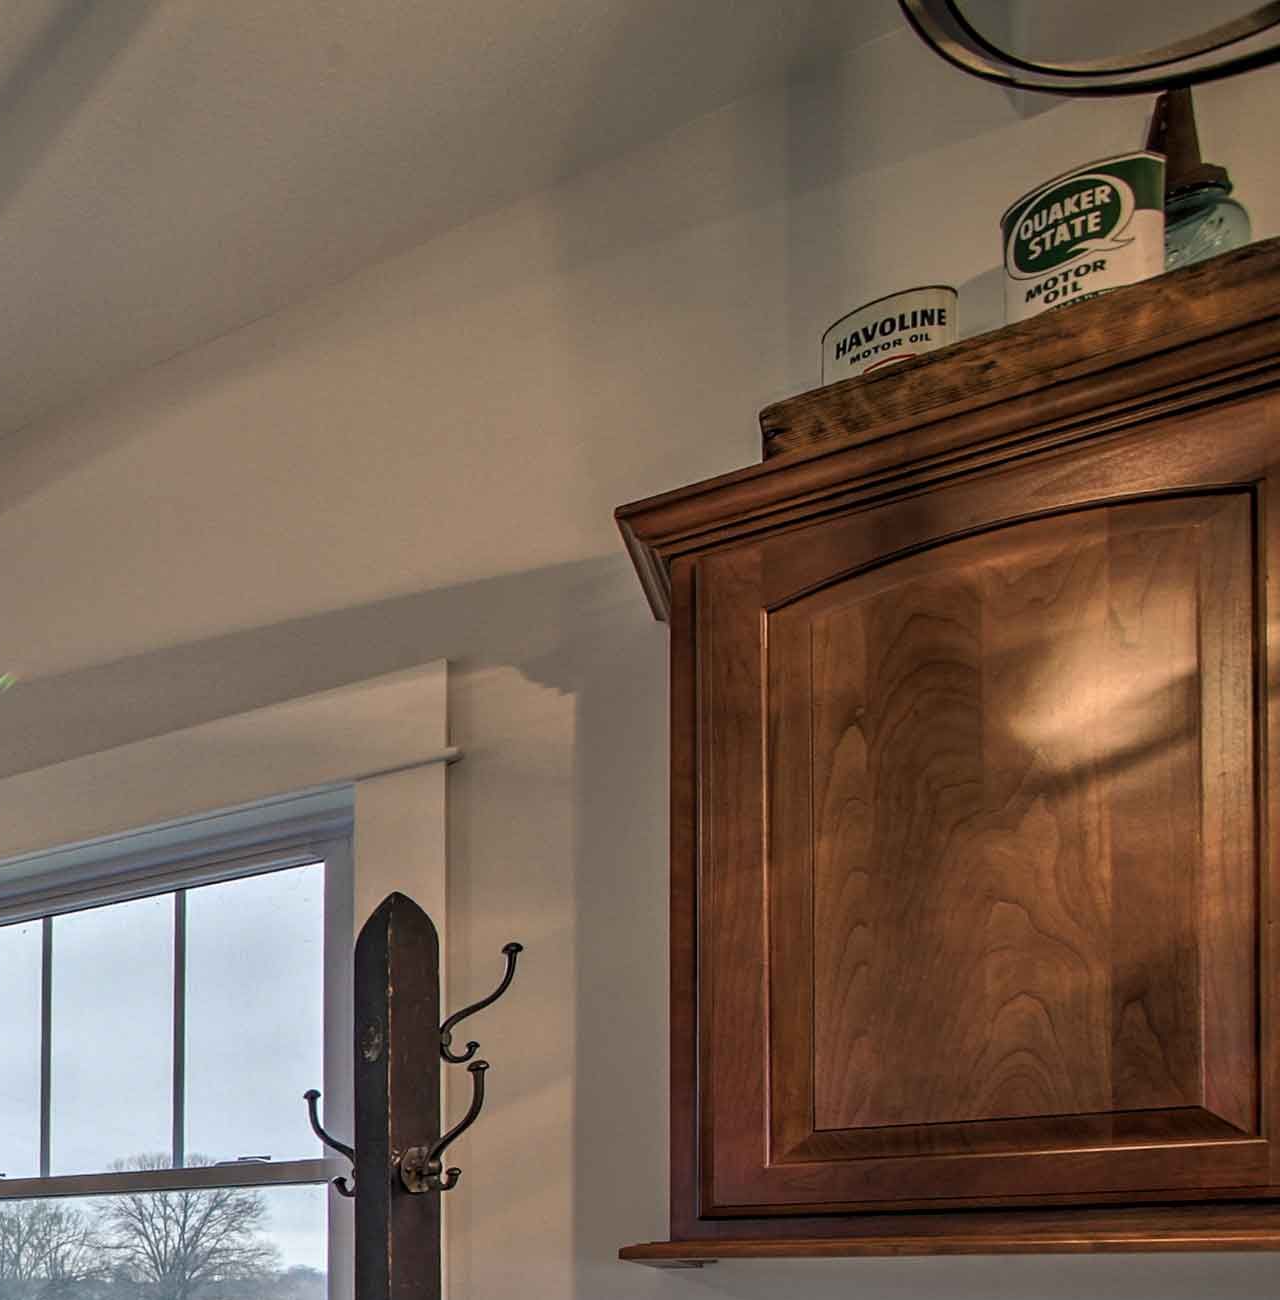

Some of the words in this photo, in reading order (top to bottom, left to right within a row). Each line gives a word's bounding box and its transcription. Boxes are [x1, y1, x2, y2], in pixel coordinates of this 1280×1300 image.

[1020, 184, 1112, 241] QUAKER
[1027, 210, 1103, 260] STATE
[1024, 258, 1106, 303] MOTOR
[1043, 281, 1083, 304] OIL
[834, 307, 947, 361] HAVOLINE
[849, 337, 903, 366] MOTOR
[909, 332, 933, 344] OIL
